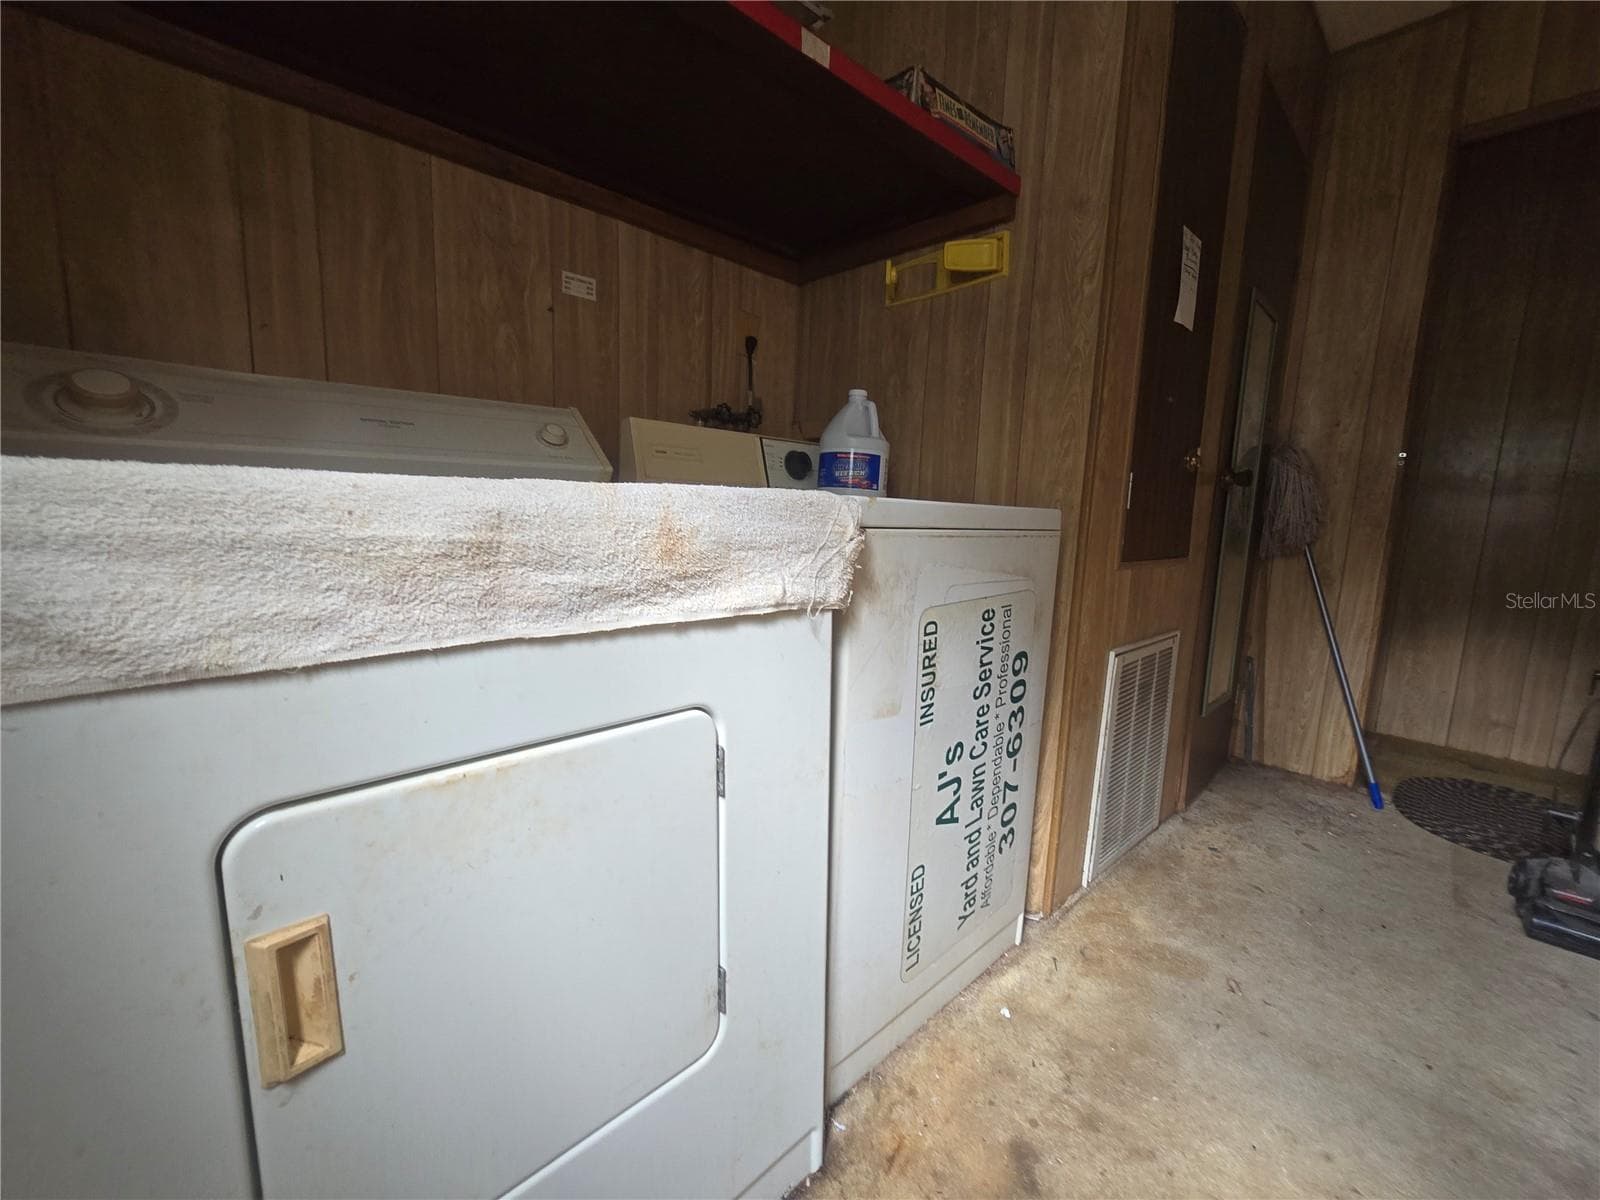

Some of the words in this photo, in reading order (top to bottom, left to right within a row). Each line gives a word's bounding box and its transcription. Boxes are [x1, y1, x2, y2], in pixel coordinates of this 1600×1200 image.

[973, 607, 996, 700] Service
[995, 603, 1013, 709] Professional
[969, 703, 990, 760] Care
[987, 721, 1005, 820] Dependable
[998, 650, 1029, 855] 307-6309
[905, 864, 926, 973] LICENSED
[919, 620, 938, 727] INSURED
[935, 741, 964, 825] AJ's
[965, 762, 987, 829] Lawn
[964, 826, 982, 871] and
[980, 830, 997, 909] Affordable
[957, 872, 978, 930] Yard
